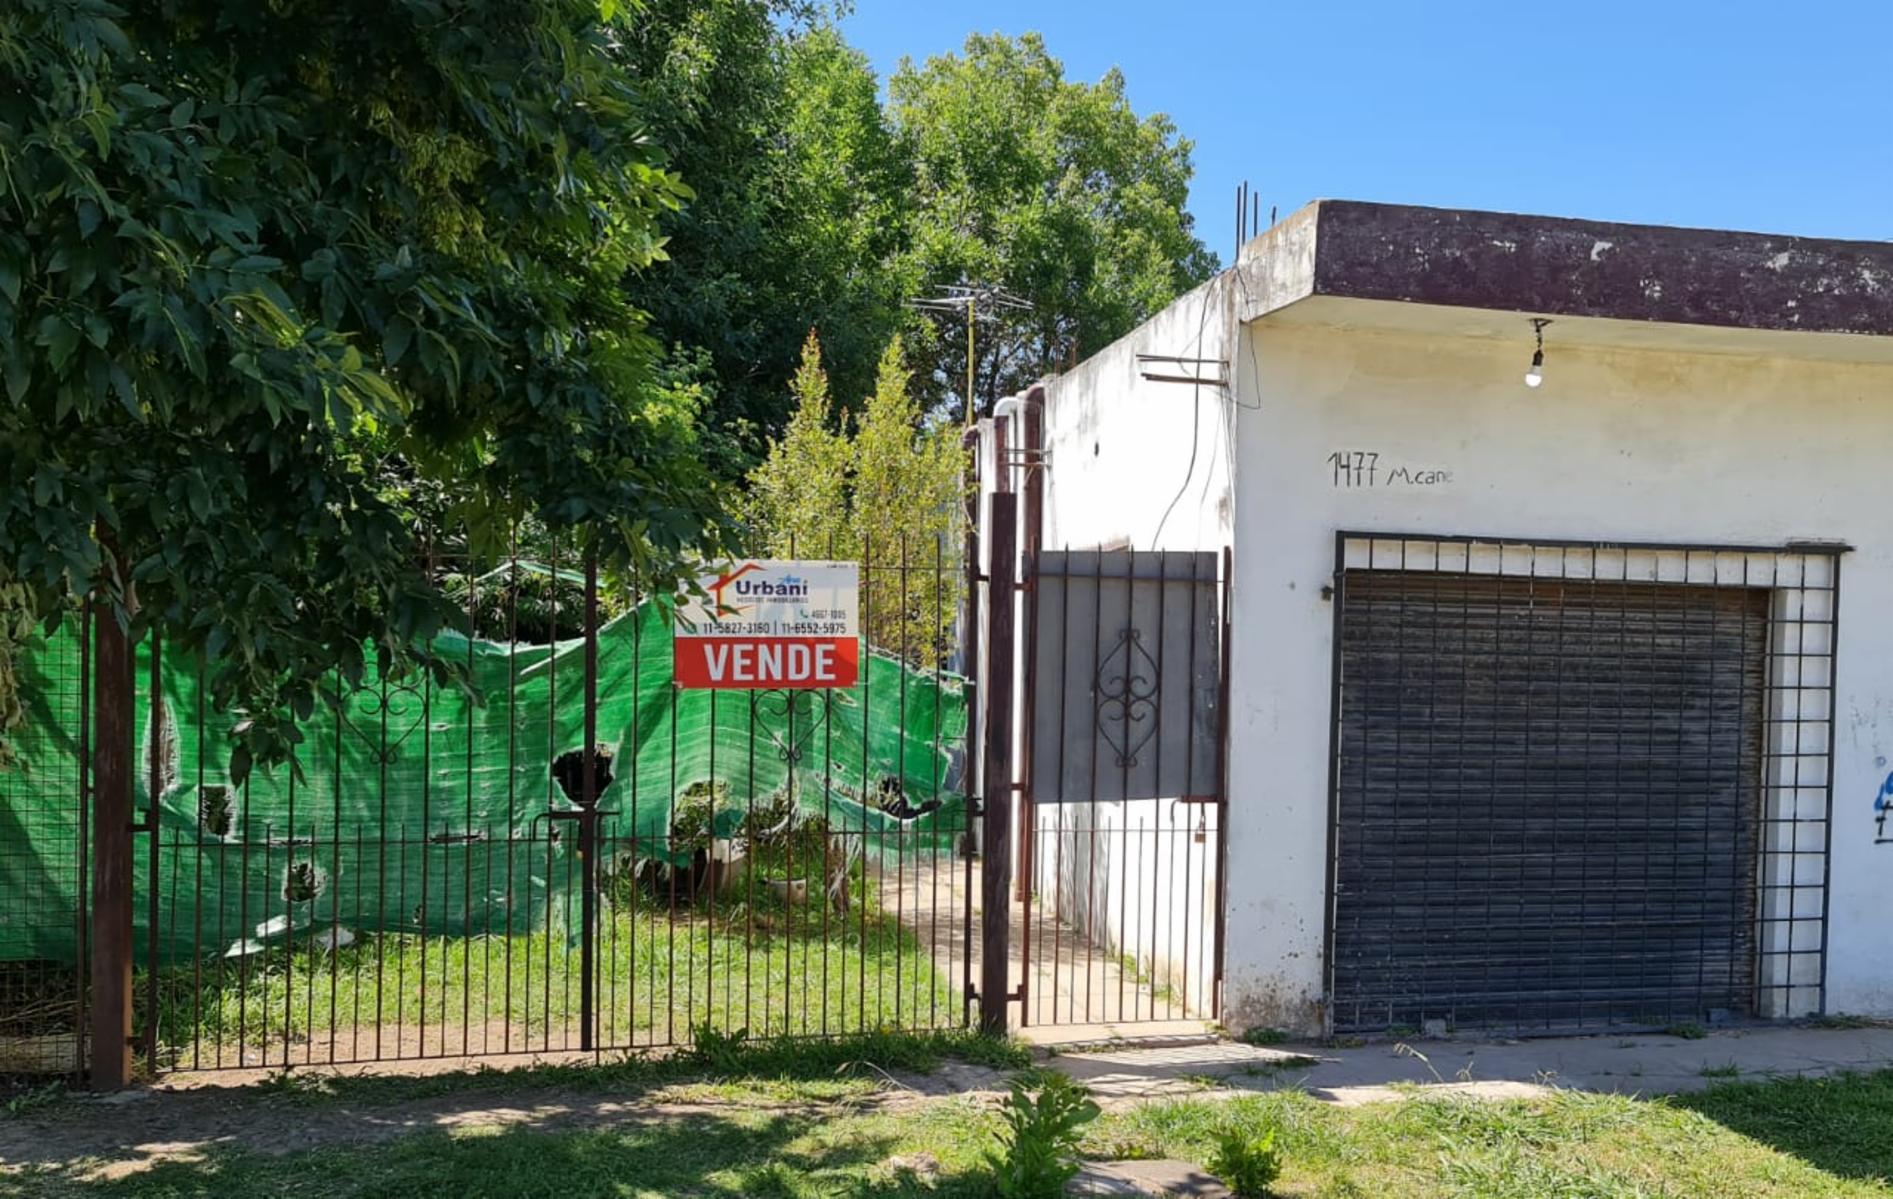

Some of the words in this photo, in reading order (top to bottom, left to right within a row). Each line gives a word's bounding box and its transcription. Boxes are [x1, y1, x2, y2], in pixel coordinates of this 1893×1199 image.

[1327, 452, 1379, 487] 1477
[736, 580, 808, 596] Urbani
[782, 622, 847, 634] 11-6552-5975
[703, 644, 836, 681] VENDE
